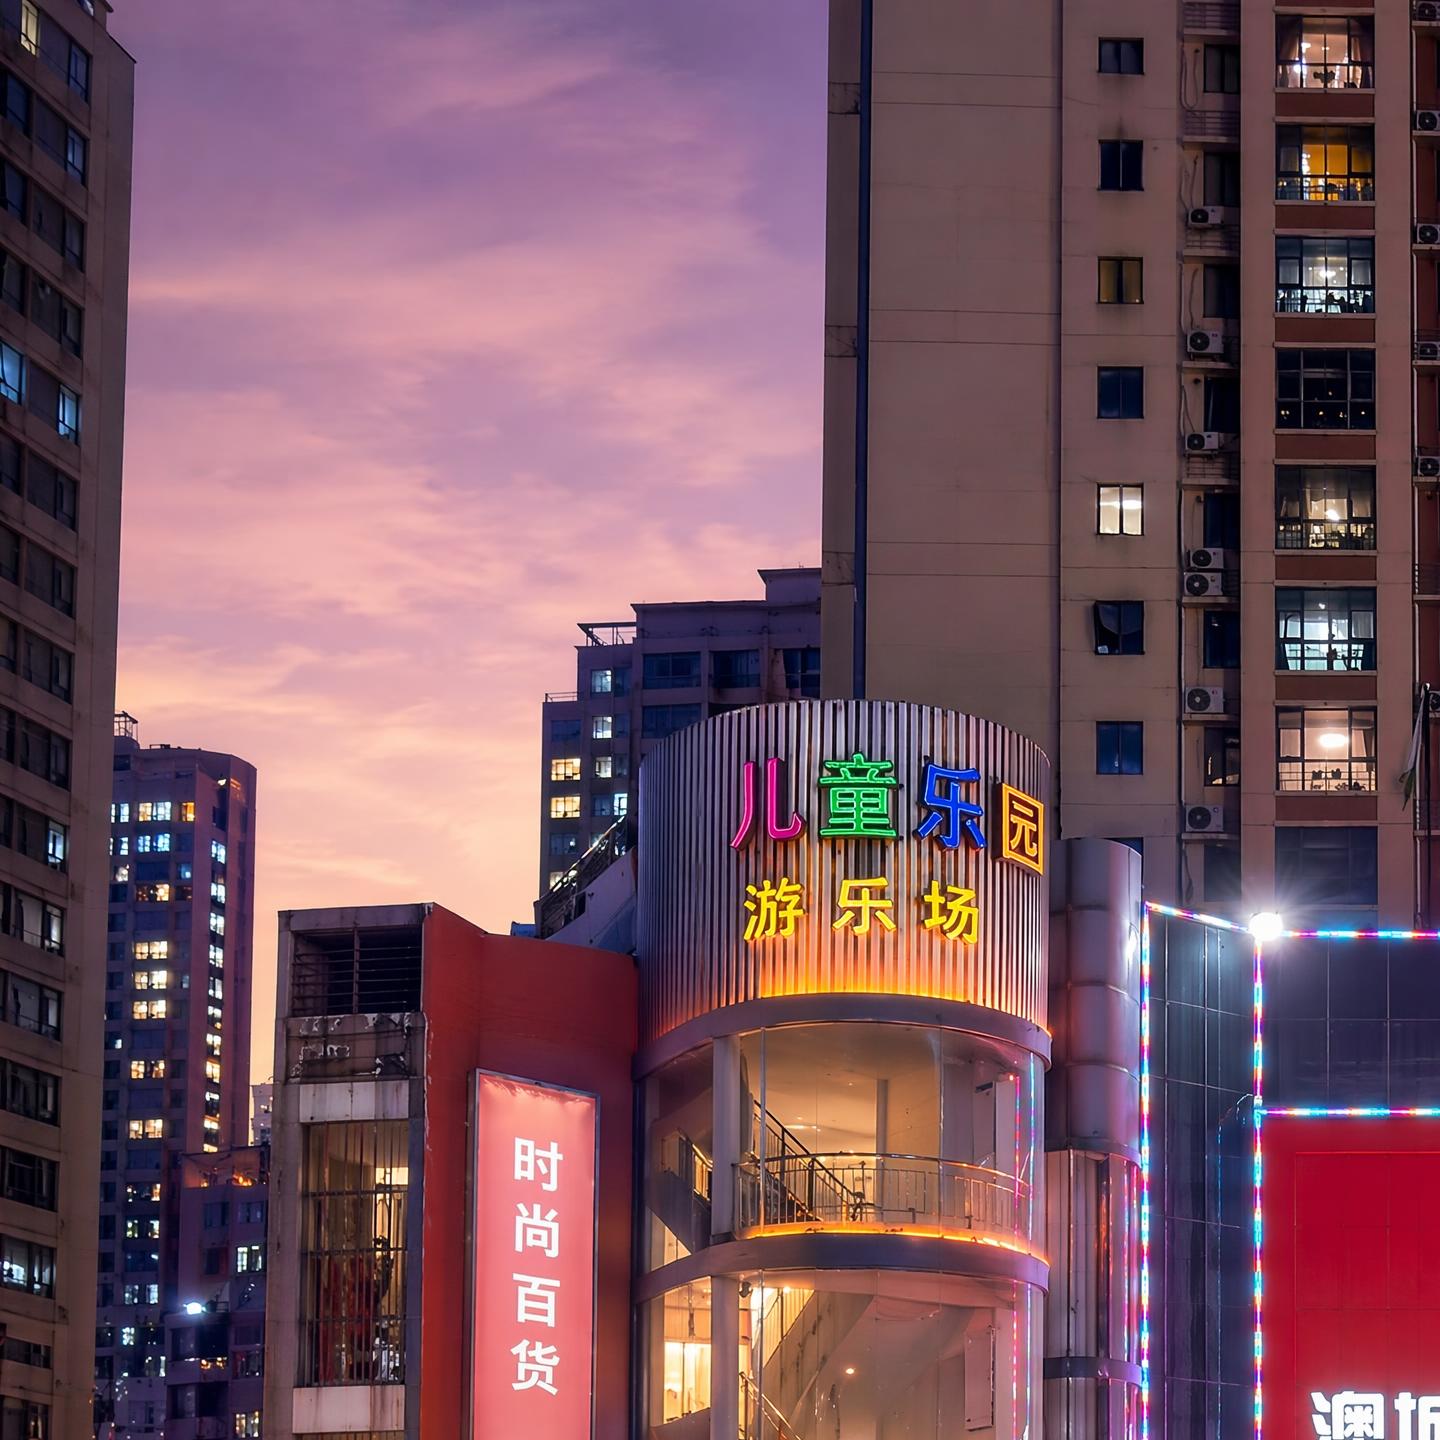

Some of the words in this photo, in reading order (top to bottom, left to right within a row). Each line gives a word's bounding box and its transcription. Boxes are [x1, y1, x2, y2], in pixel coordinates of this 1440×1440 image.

[730, 752, 1045, 876] 儿童乐园
[743, 876, 980, 944] 游乐场
[510, 1137, 563, 1395] 时尚百货
